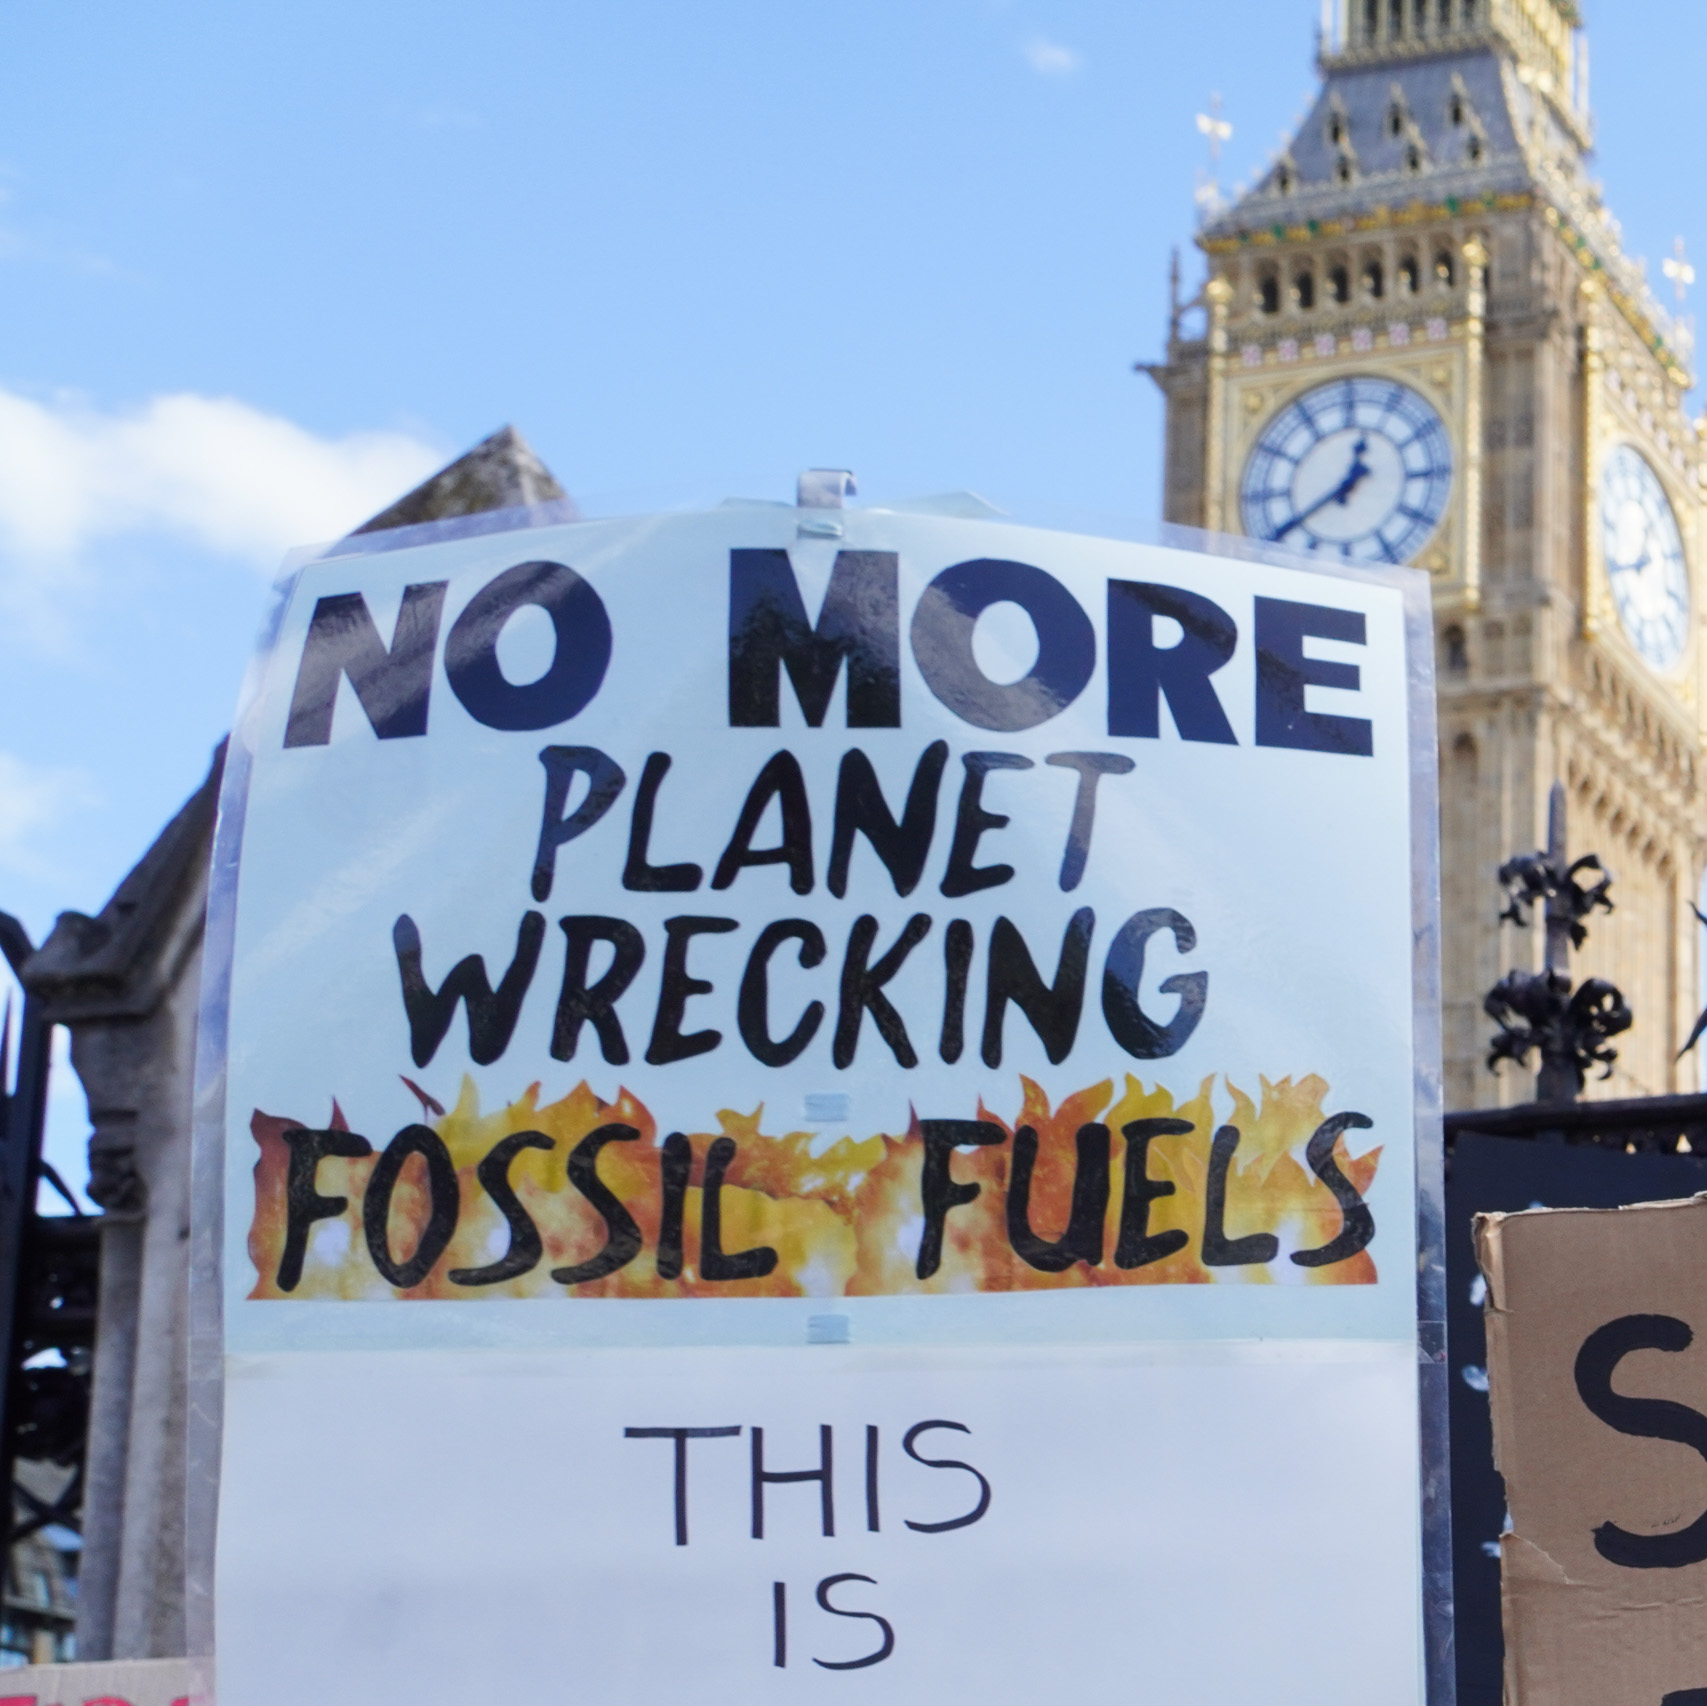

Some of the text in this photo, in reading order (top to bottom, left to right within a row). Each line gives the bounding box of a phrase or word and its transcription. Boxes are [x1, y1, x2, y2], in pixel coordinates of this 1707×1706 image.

[284, 548, 1373, 757] NO MORE
[531, 740, 1135, 898] PLANET
[393, 907, 1207, 1070] WRECKING
[277, 1111, 1375, 1289] FOSSIL FUELS
[625, 1420, 991, 1546] THIS
[774, 1573, 895, 1671] IS
